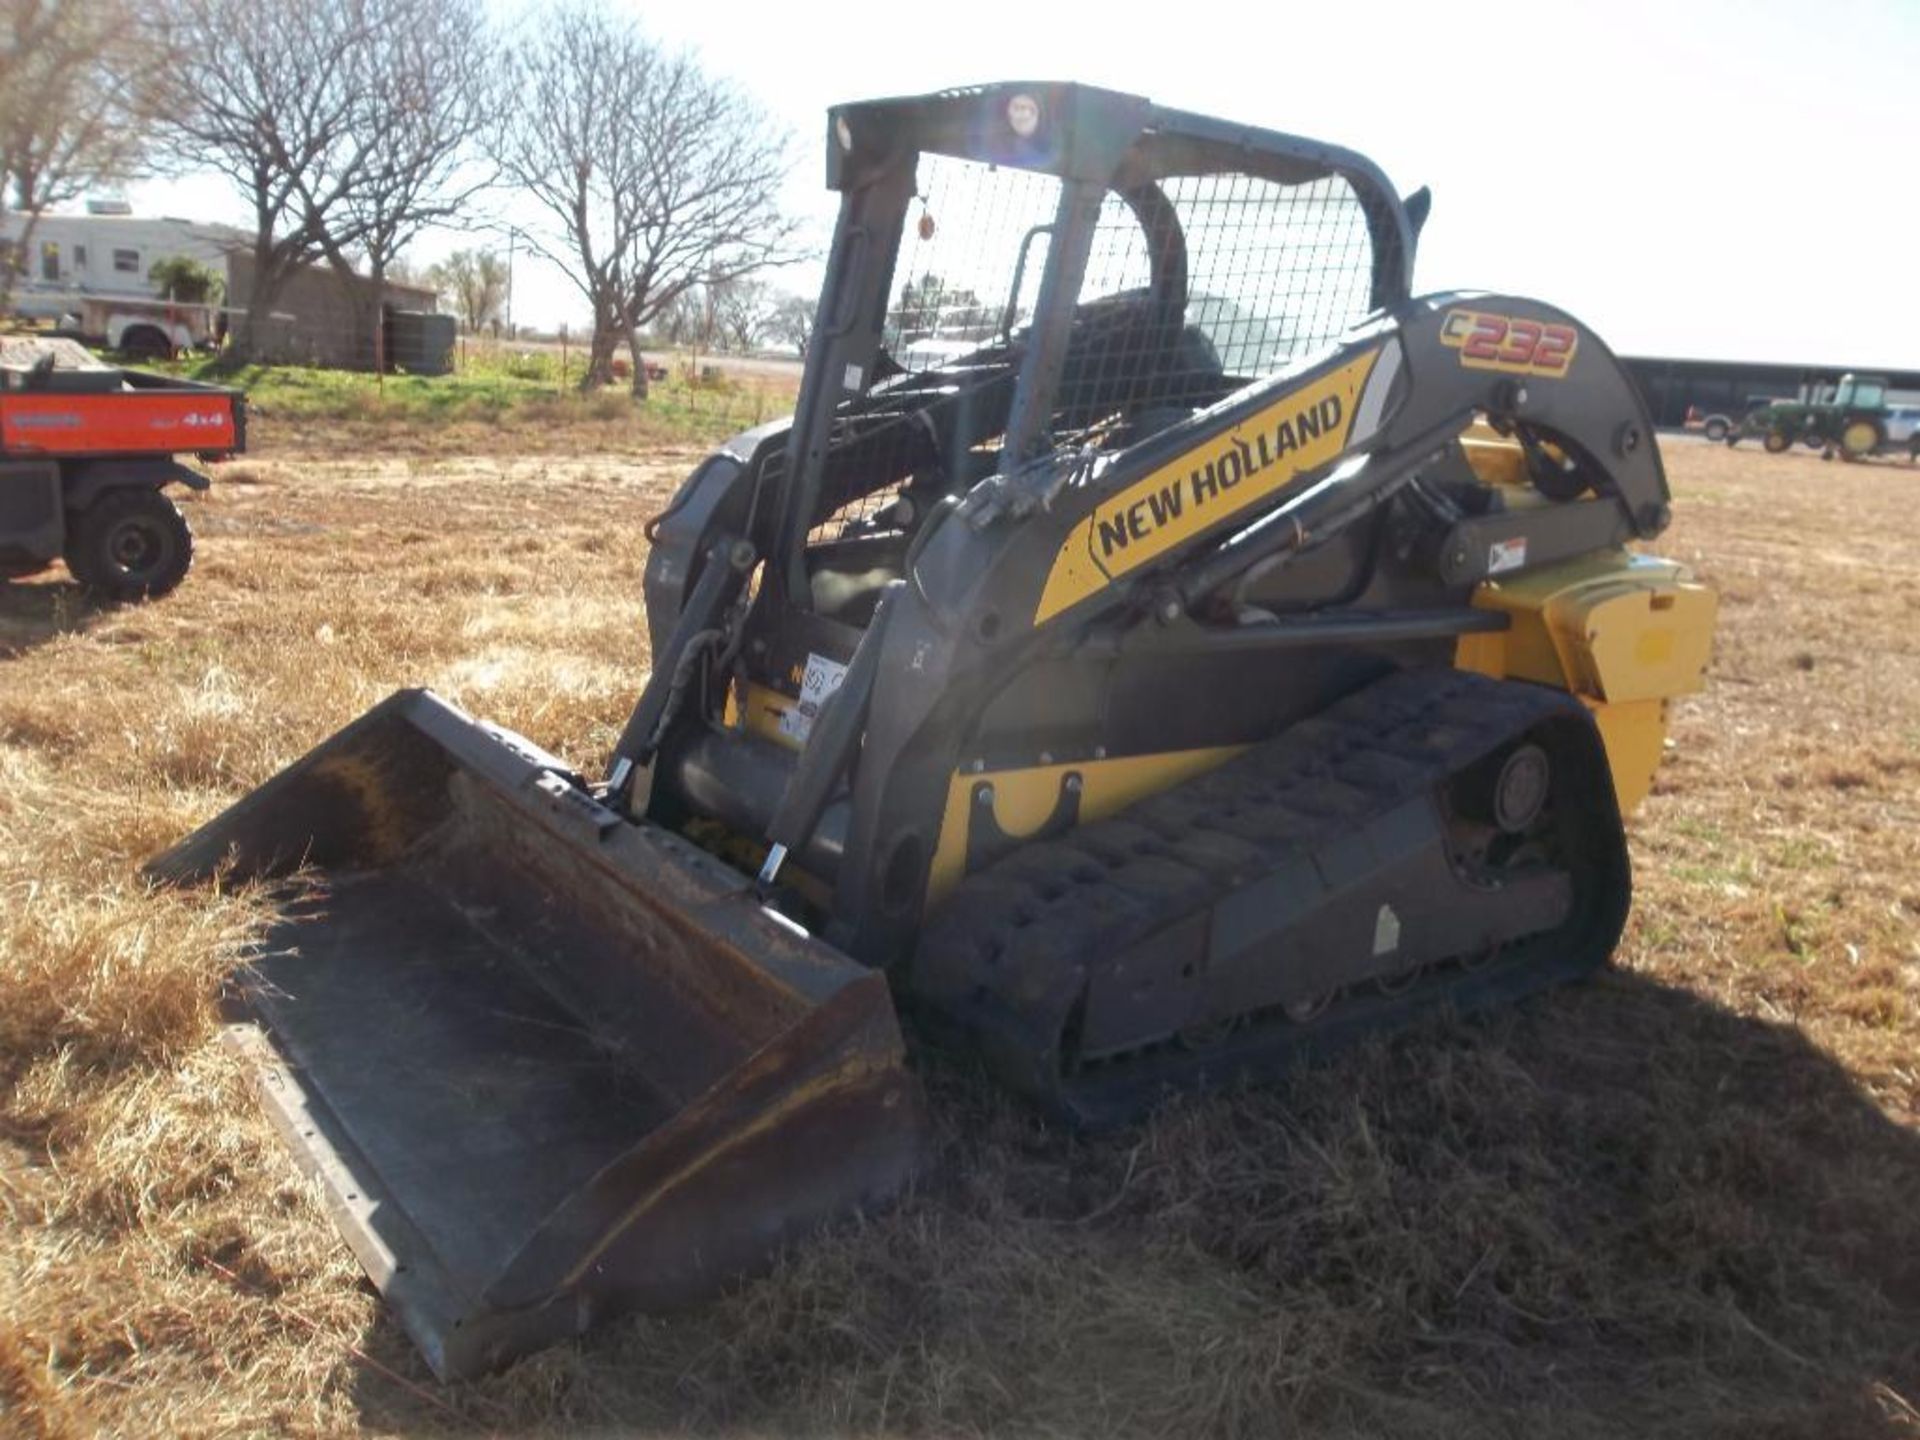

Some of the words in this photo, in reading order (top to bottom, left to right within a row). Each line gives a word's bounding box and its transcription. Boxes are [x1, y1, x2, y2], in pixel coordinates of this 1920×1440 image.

[182, 412, 224, 427] 4x4
[1097, 480, 1183, 557] NEW
[1191, 394, 1343, 505] HOLLAND
